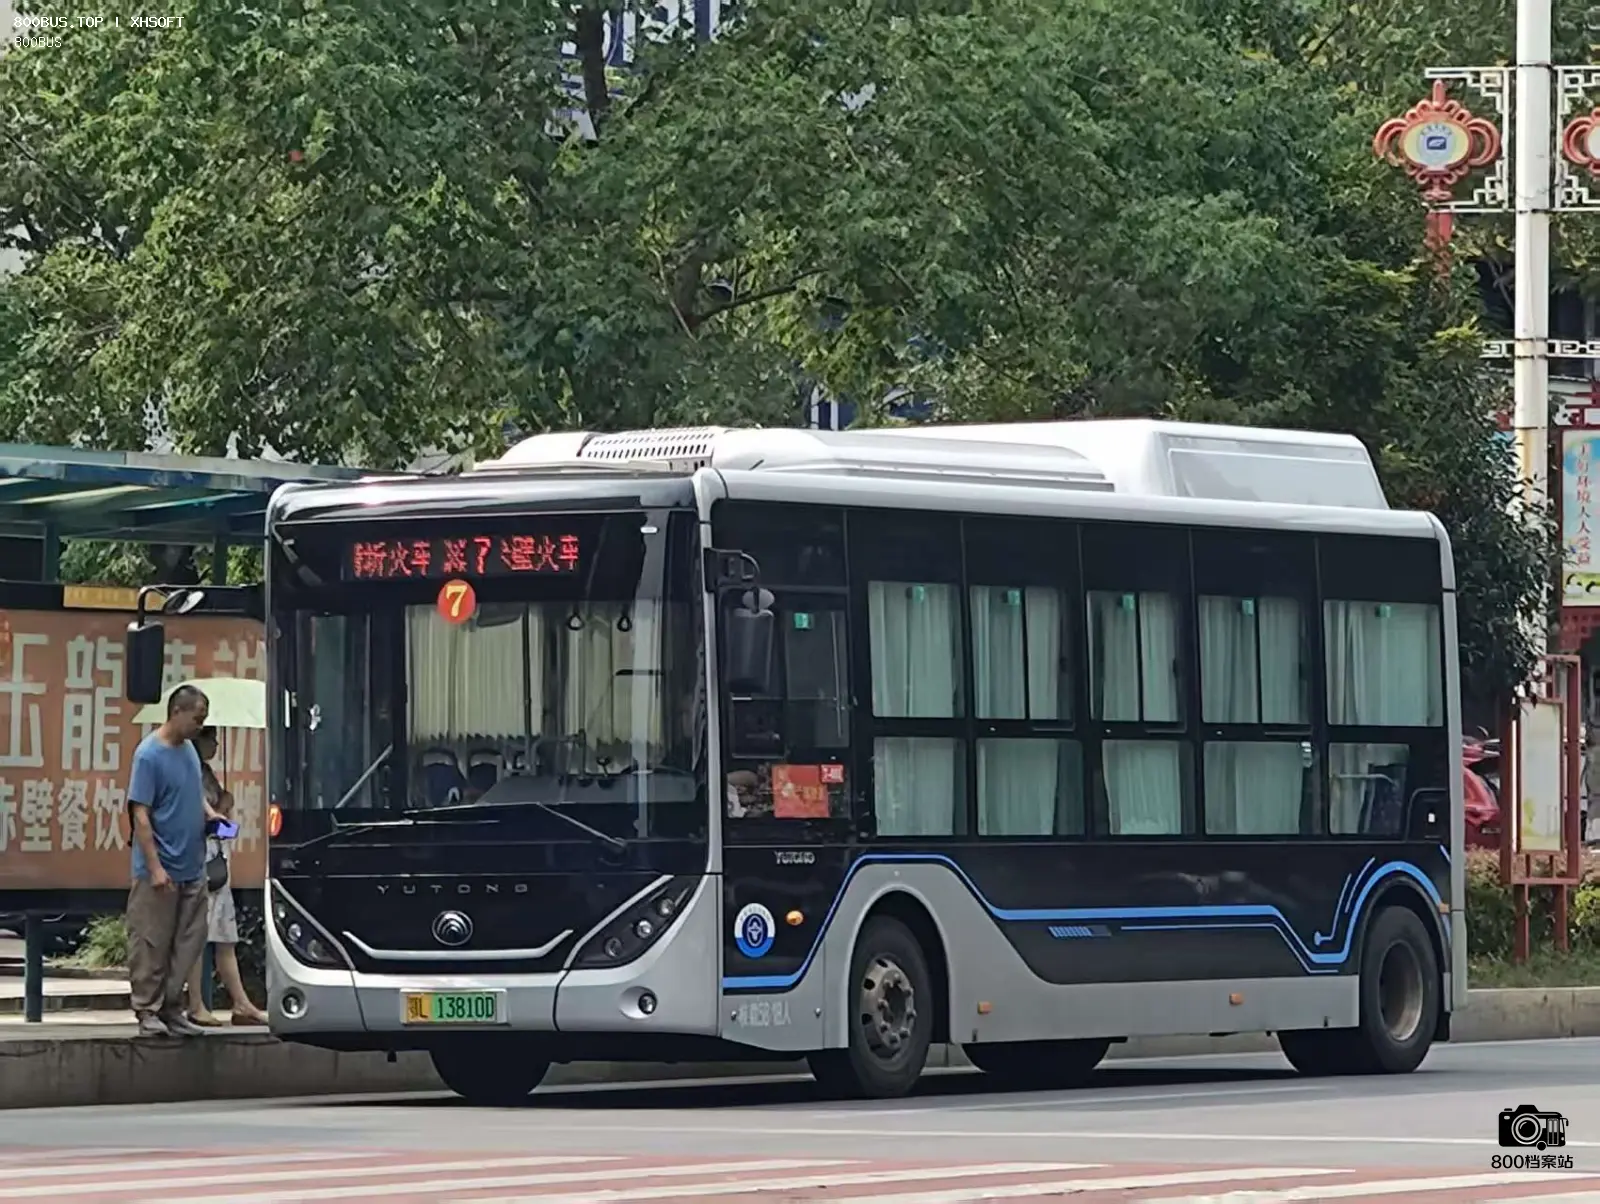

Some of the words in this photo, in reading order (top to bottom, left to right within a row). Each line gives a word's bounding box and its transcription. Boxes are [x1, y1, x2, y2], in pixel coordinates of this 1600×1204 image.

[445, 584, 468, 617] 7
[376, 883, 529, 895] YUTONG
[437, 996, 494, 1018] 13810D
